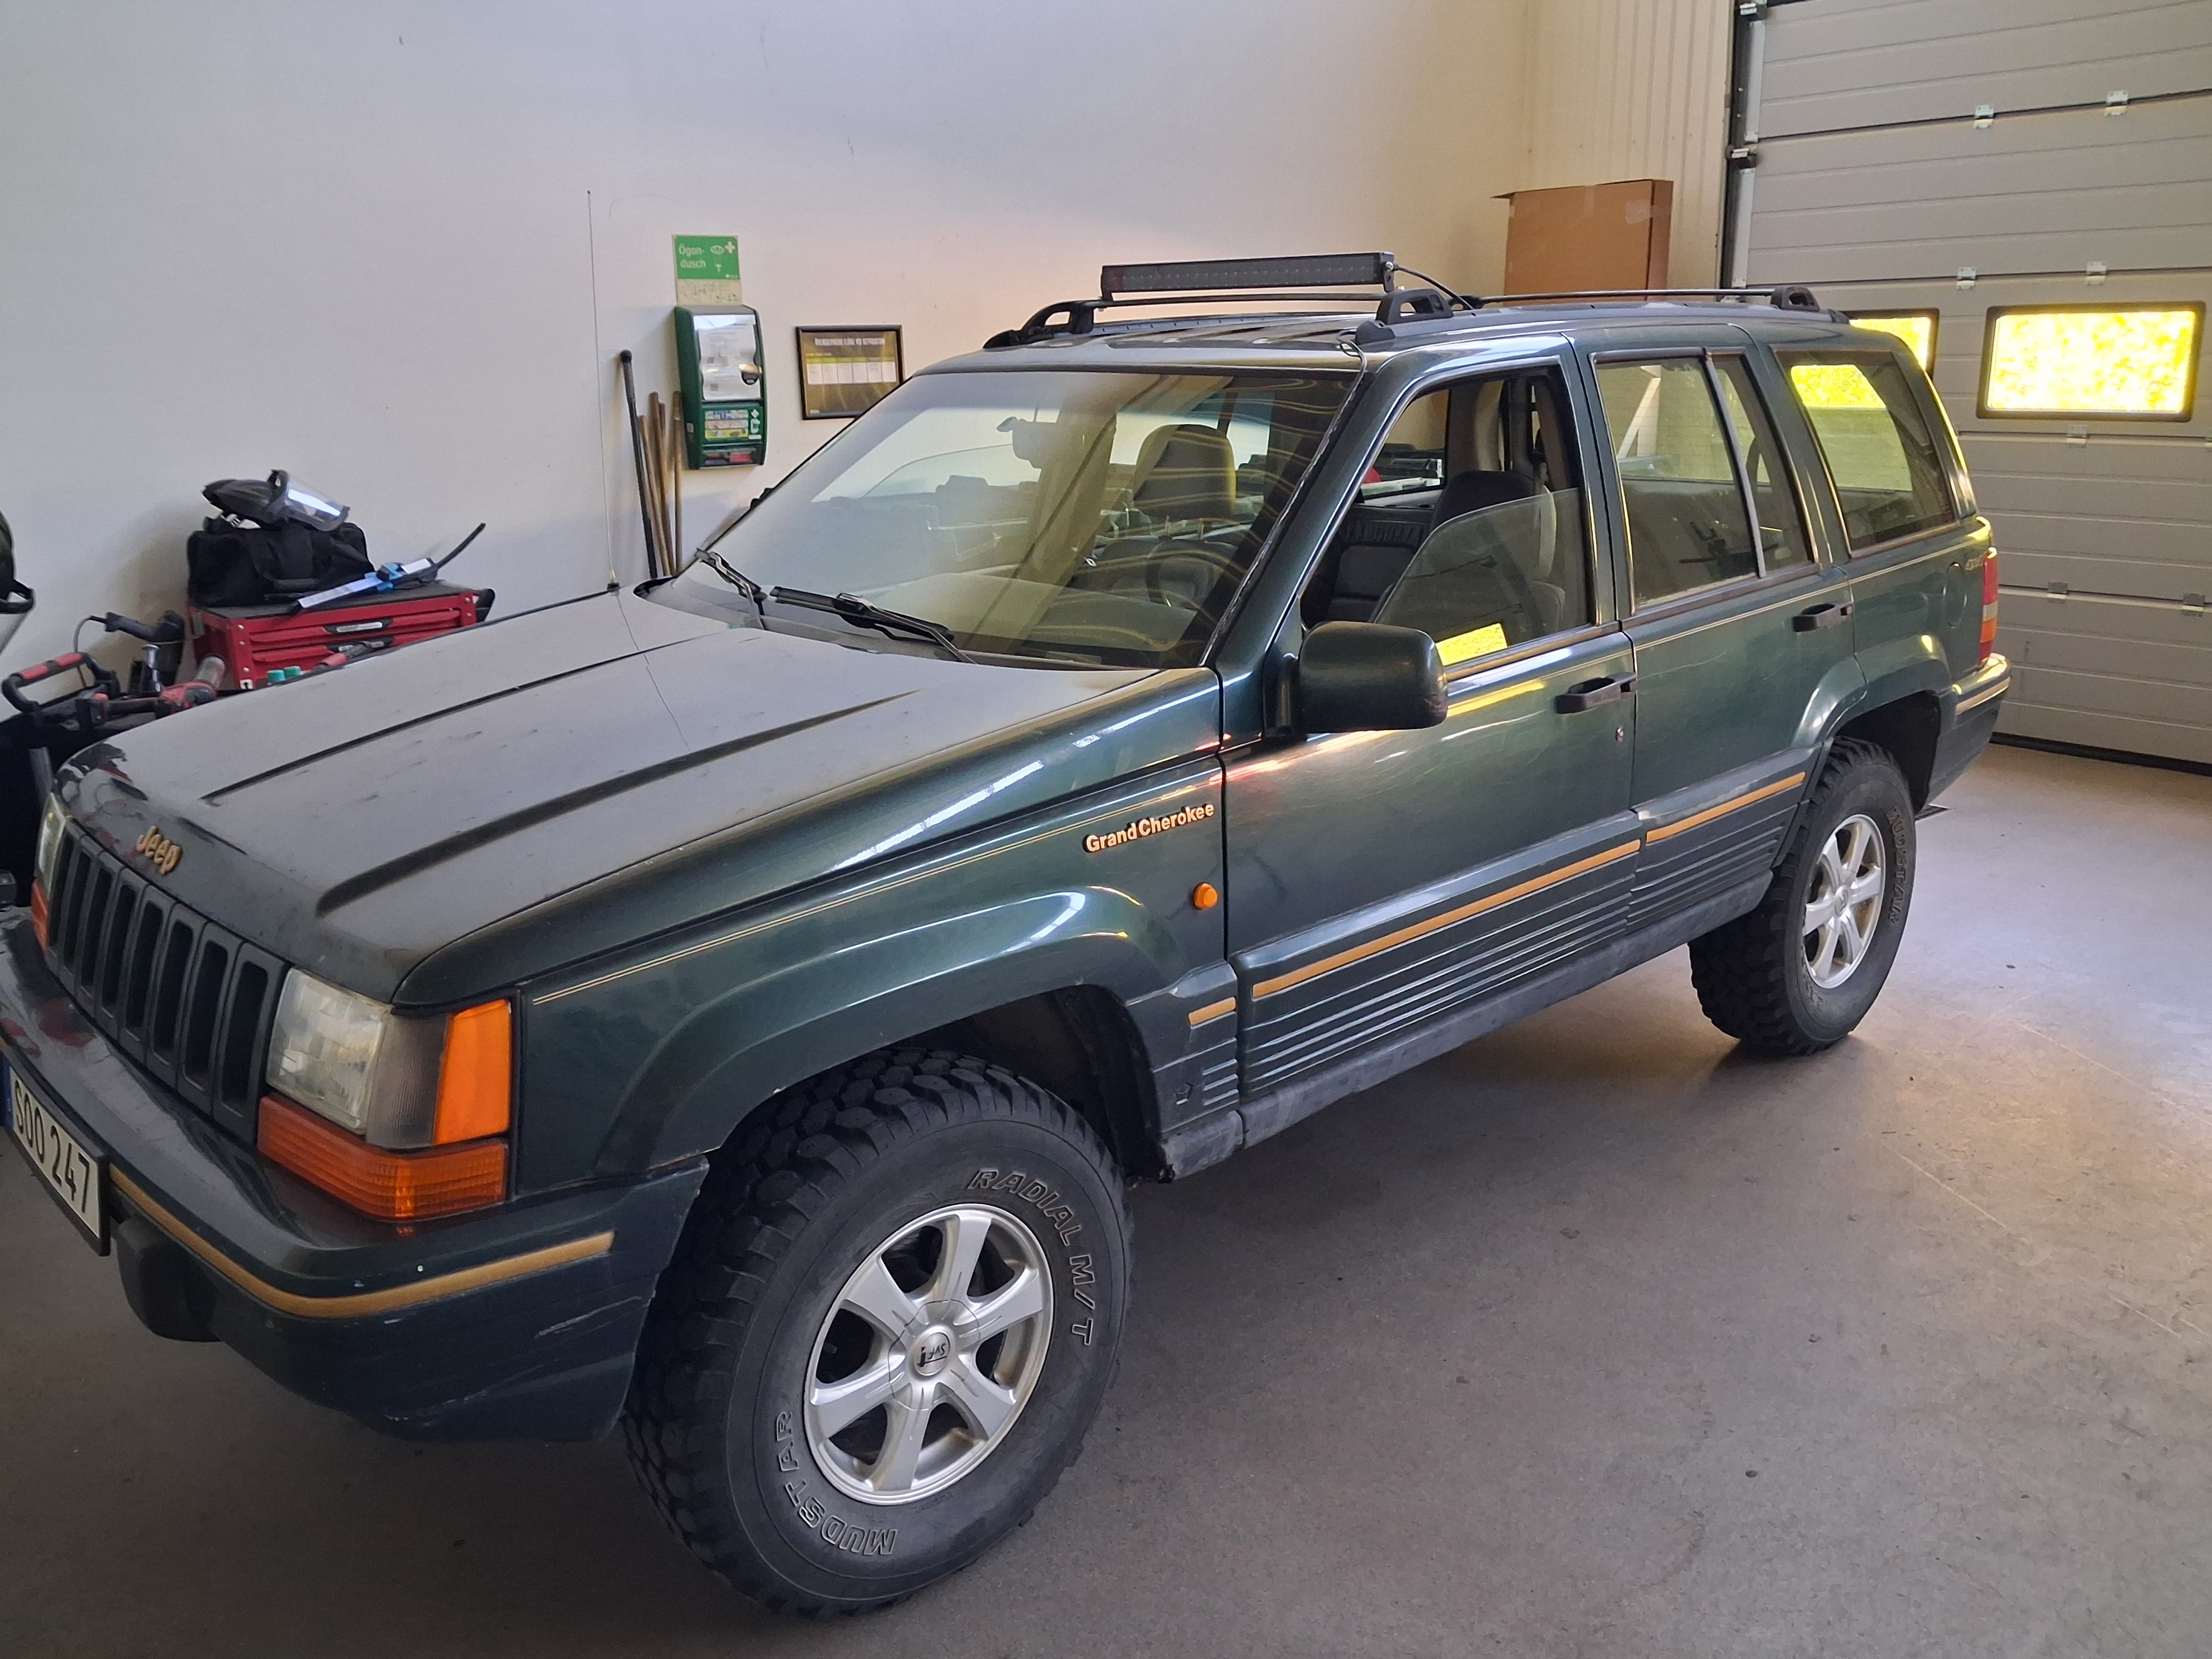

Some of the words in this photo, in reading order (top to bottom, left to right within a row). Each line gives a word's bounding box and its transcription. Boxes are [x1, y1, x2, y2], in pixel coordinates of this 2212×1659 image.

[681, 259, 706, 268] dusch
[136, 826, 181, 875] Jeep
[50, 1124, 91, 1214] 247
[967, 1168, 1082, 1246] RADIAL
[1069, 1254, 1096, 1346] M/T
